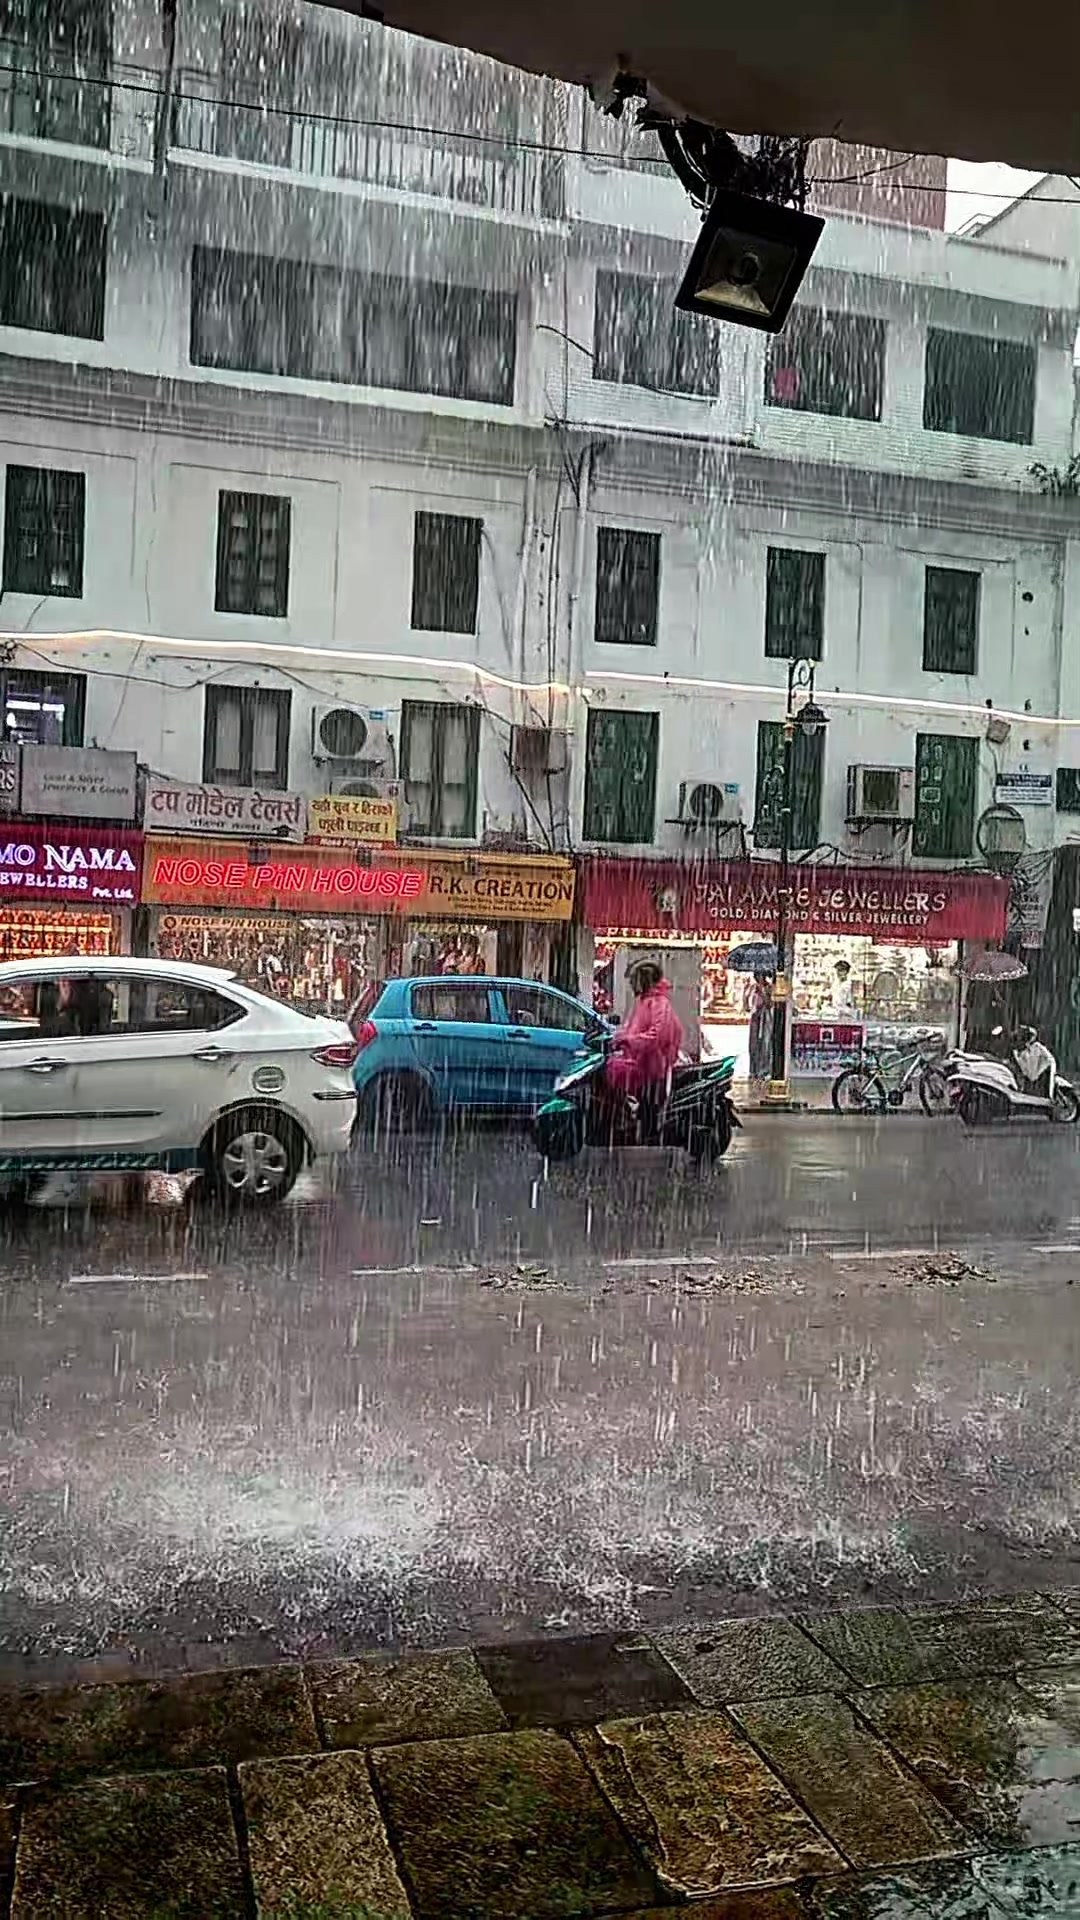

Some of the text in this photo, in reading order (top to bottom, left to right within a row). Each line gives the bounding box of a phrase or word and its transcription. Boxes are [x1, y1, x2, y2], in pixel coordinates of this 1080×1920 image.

[186, 786, 244, 818] मोडेल
[43, 844, 136, 872] NAMA
[152, 859, 249, 888] NOSE
[310, 867, 421, 897] HOUSE
[430, 876, 573, 901] R.K. CREATION
[92, 886, 113, 898] Pvt.
[114, 888, 134, 899] Ltd.
[818, 887, 946, 912] JEWELLERS
[180, 917, 219, 927] NOSE
[247, 919, 293, 929] HOUSE
[824, 912, 863, 923] SILVER
[866, 913, 929, 925] JEWELLERY
